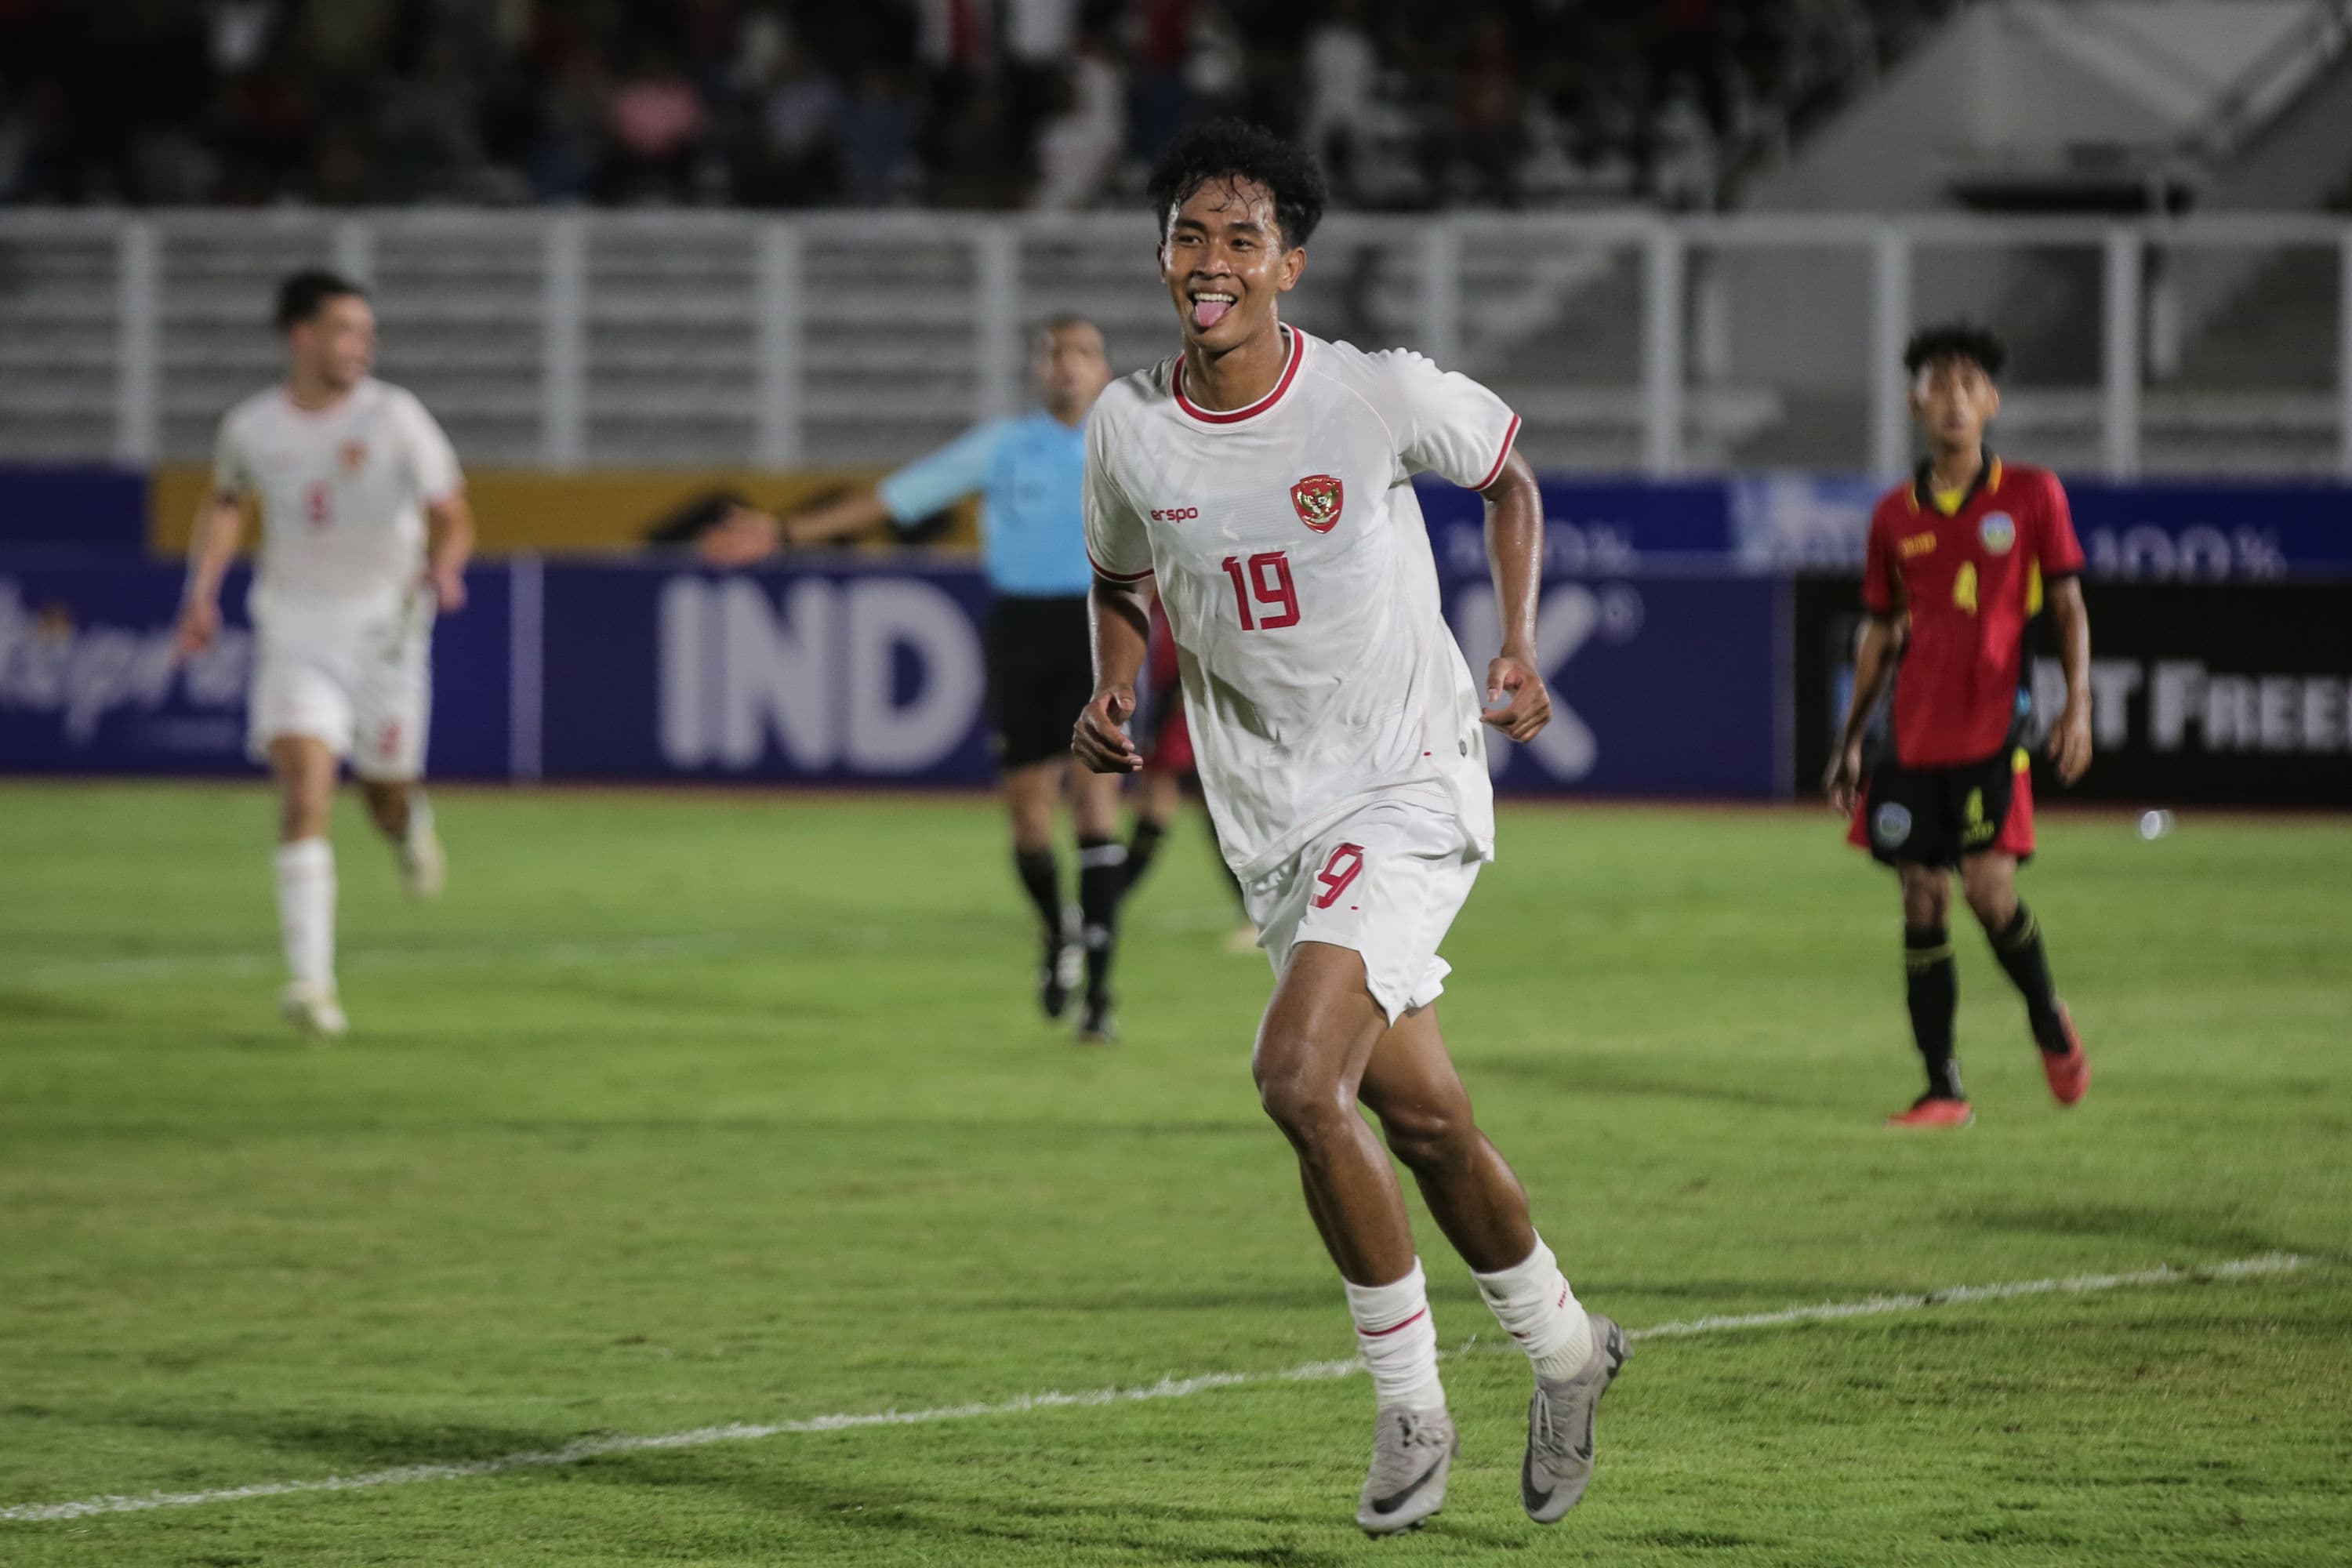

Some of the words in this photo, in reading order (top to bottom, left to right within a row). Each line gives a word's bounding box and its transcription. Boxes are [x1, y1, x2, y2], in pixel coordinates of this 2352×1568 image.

[1150, 506, 1199, 524] erspo
[1221, 550, 1301, 631] 19
[1952, 559, 1979, 616] 4
[1308, 842, 1367, 910] 9
